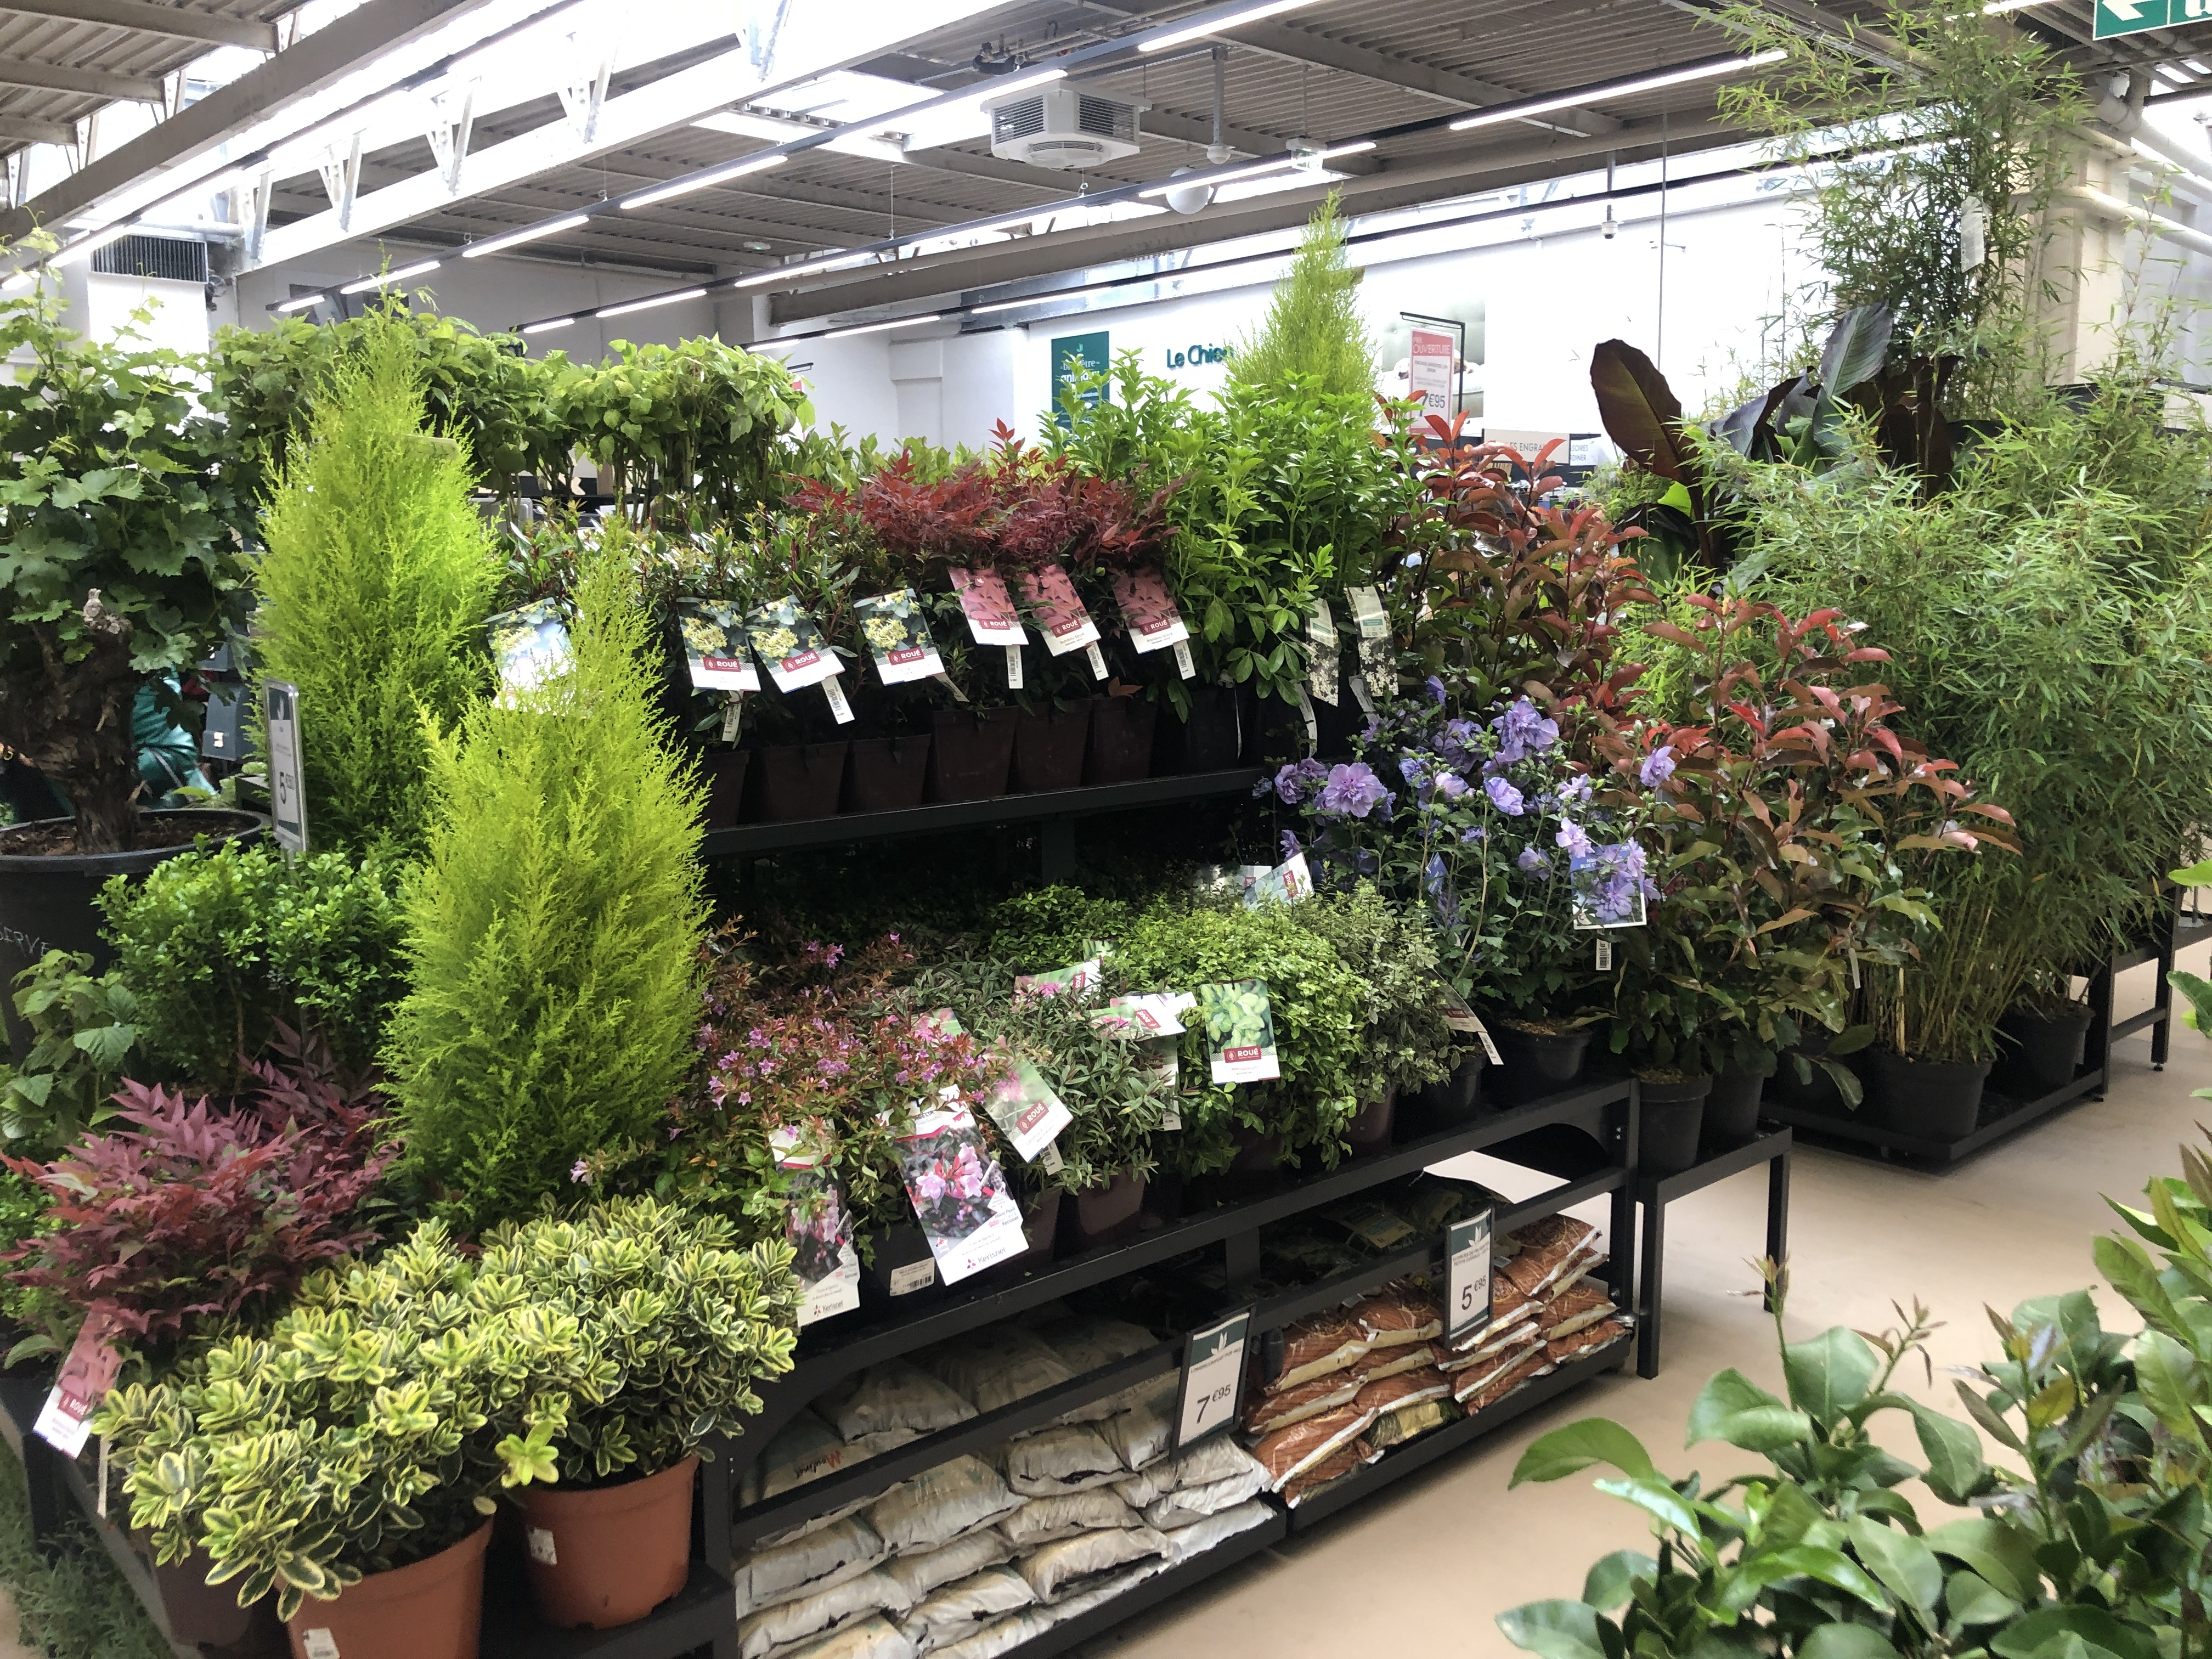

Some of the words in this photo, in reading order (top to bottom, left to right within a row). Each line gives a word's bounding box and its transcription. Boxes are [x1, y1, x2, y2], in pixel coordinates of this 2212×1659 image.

[1413, 344, 1451, 354] OUVERTURE
[1167, 349, 1185, 368] Le
[1062, 619, 1079, 630] ROUÉ
[1150, 619, 1168, 629] ROUÉ
[795, 653, 817, 665] ROUÉ
[901, 650, 922, 659] ROUÉ
[1137, 1011, 1152, 1023] ROUÉ
[1237, 1047, 1259, 1057] ROUÉ
[1026, 1103, 1045, 1122] ROUÉ
[978, 1246, 1006, 1264] Kerisnel
[822, 1300, 844, 1311] Kerisnel
